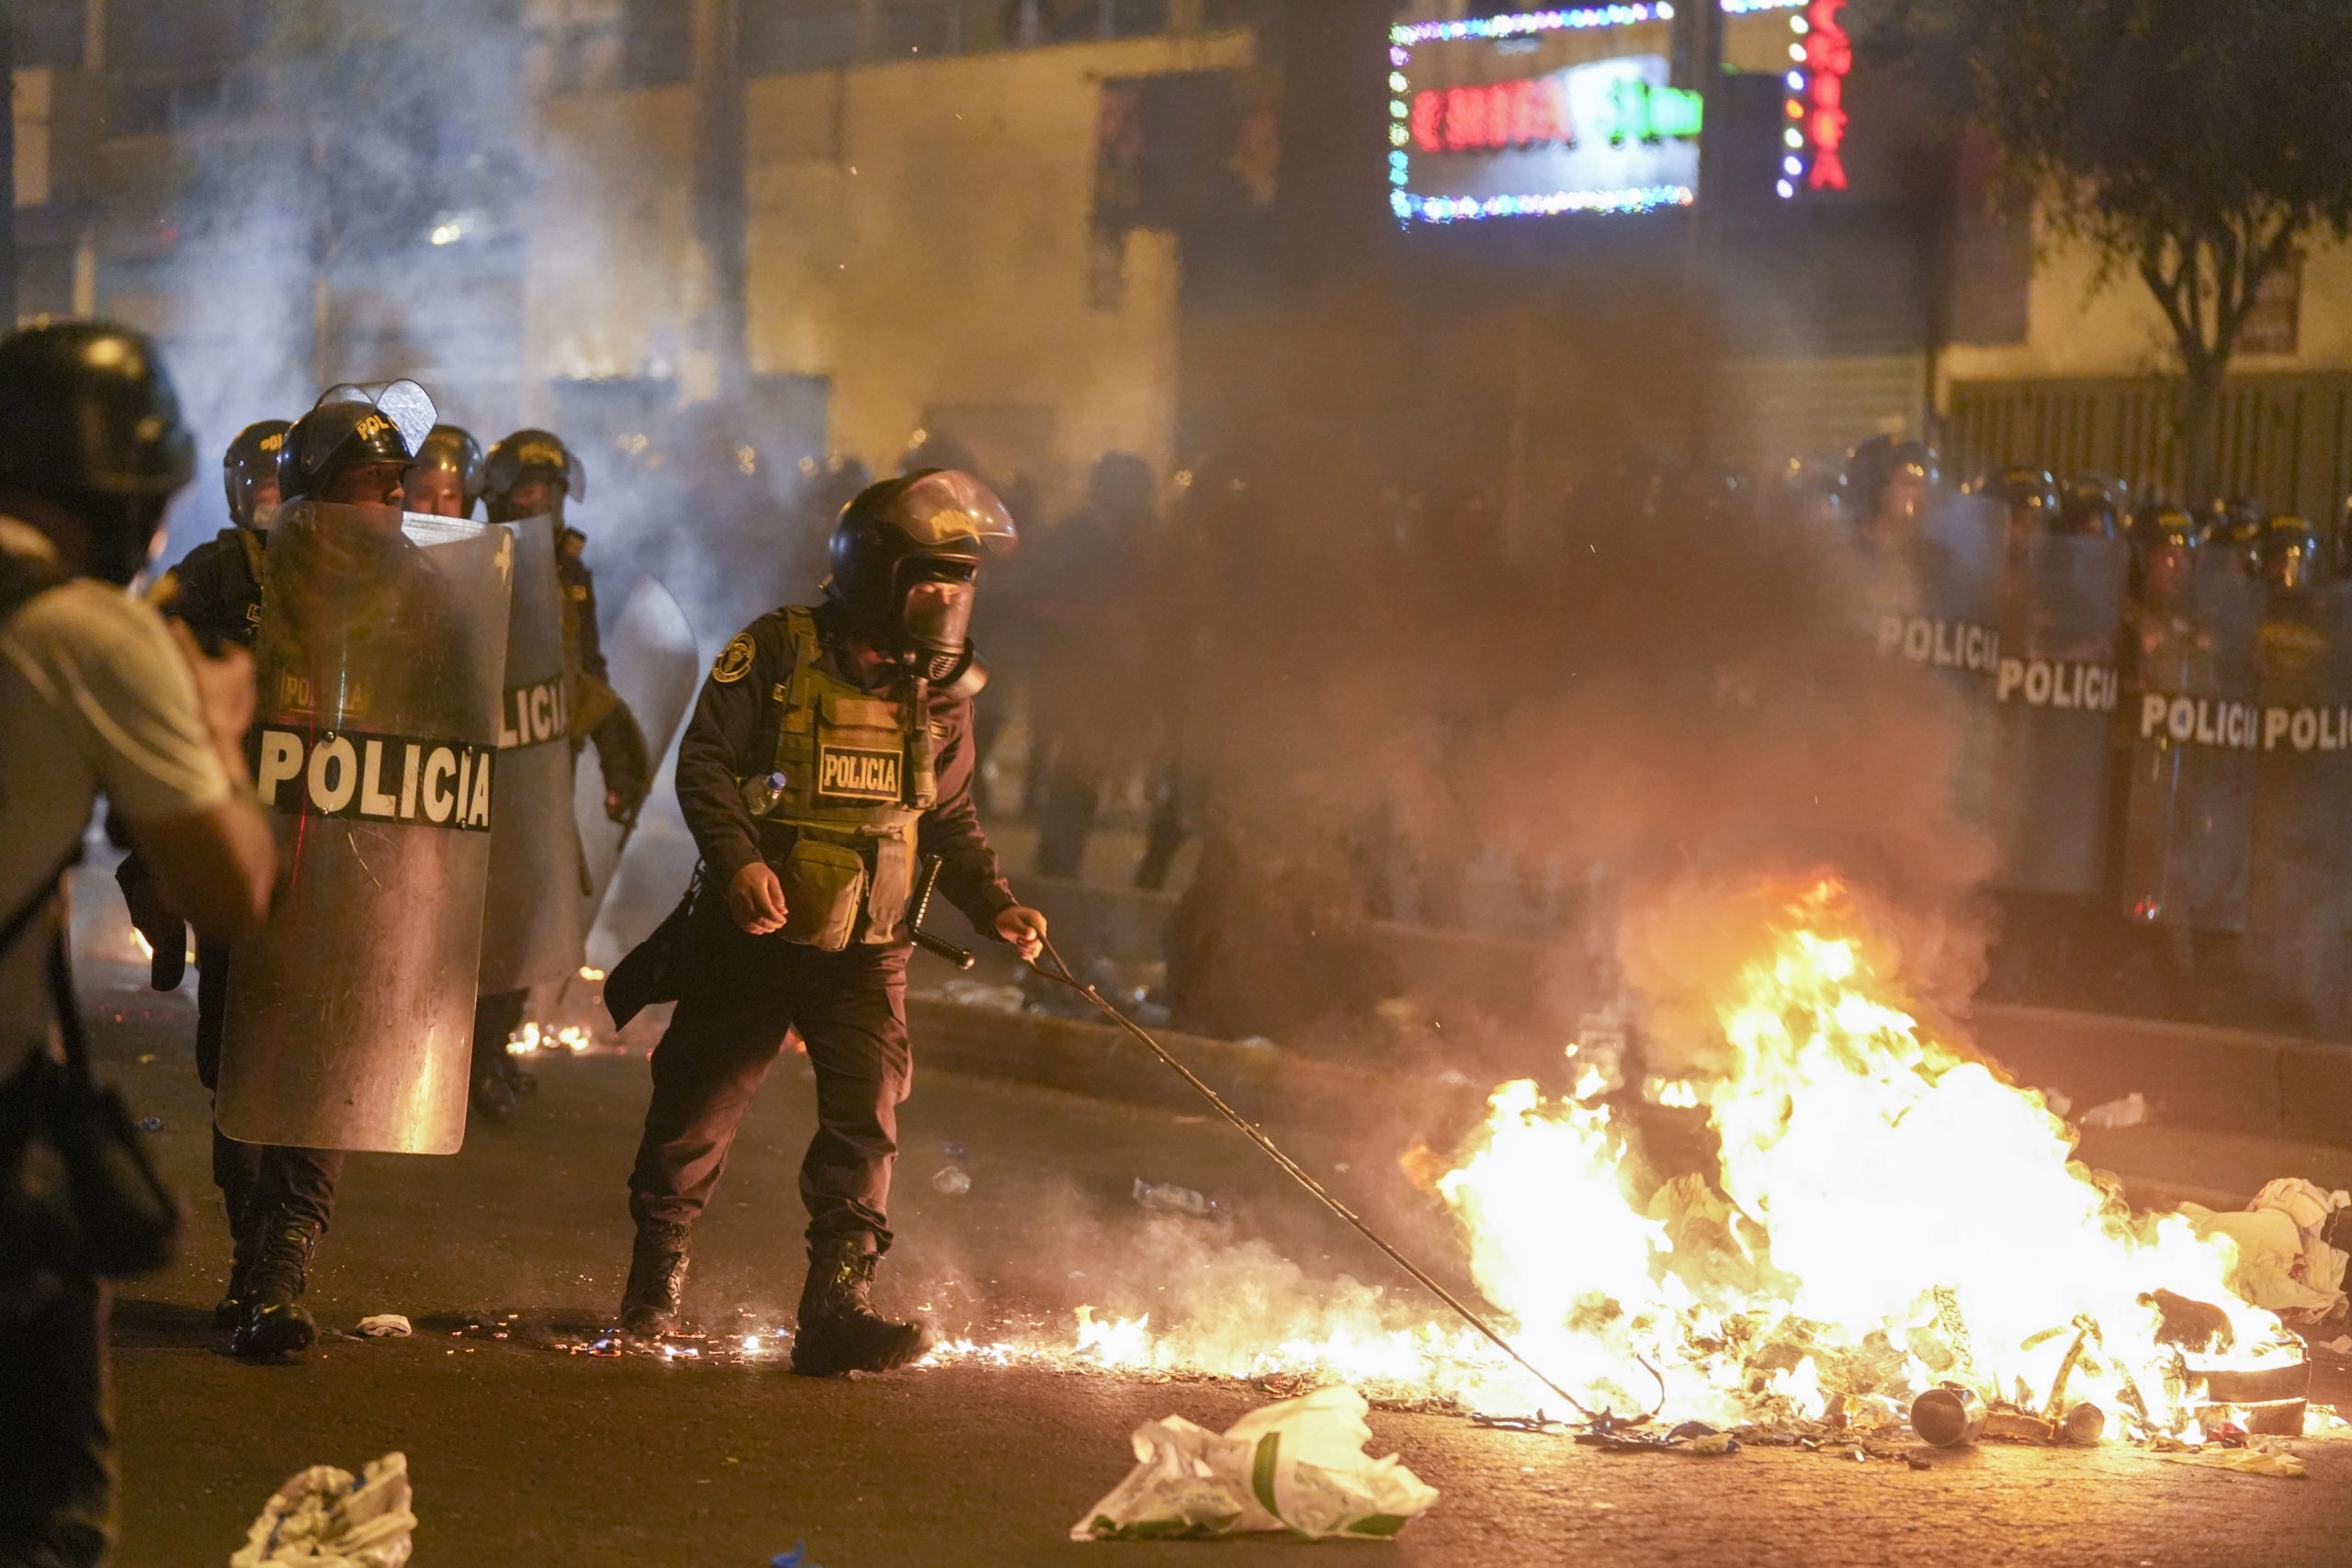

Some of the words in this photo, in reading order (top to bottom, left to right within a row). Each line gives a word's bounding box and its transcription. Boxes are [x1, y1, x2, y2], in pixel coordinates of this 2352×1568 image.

[2265, 705, 2352, 750] POLI
[257, 730, 489, 827] POLICIA
[824, 754, 897, 792] POLICIA
